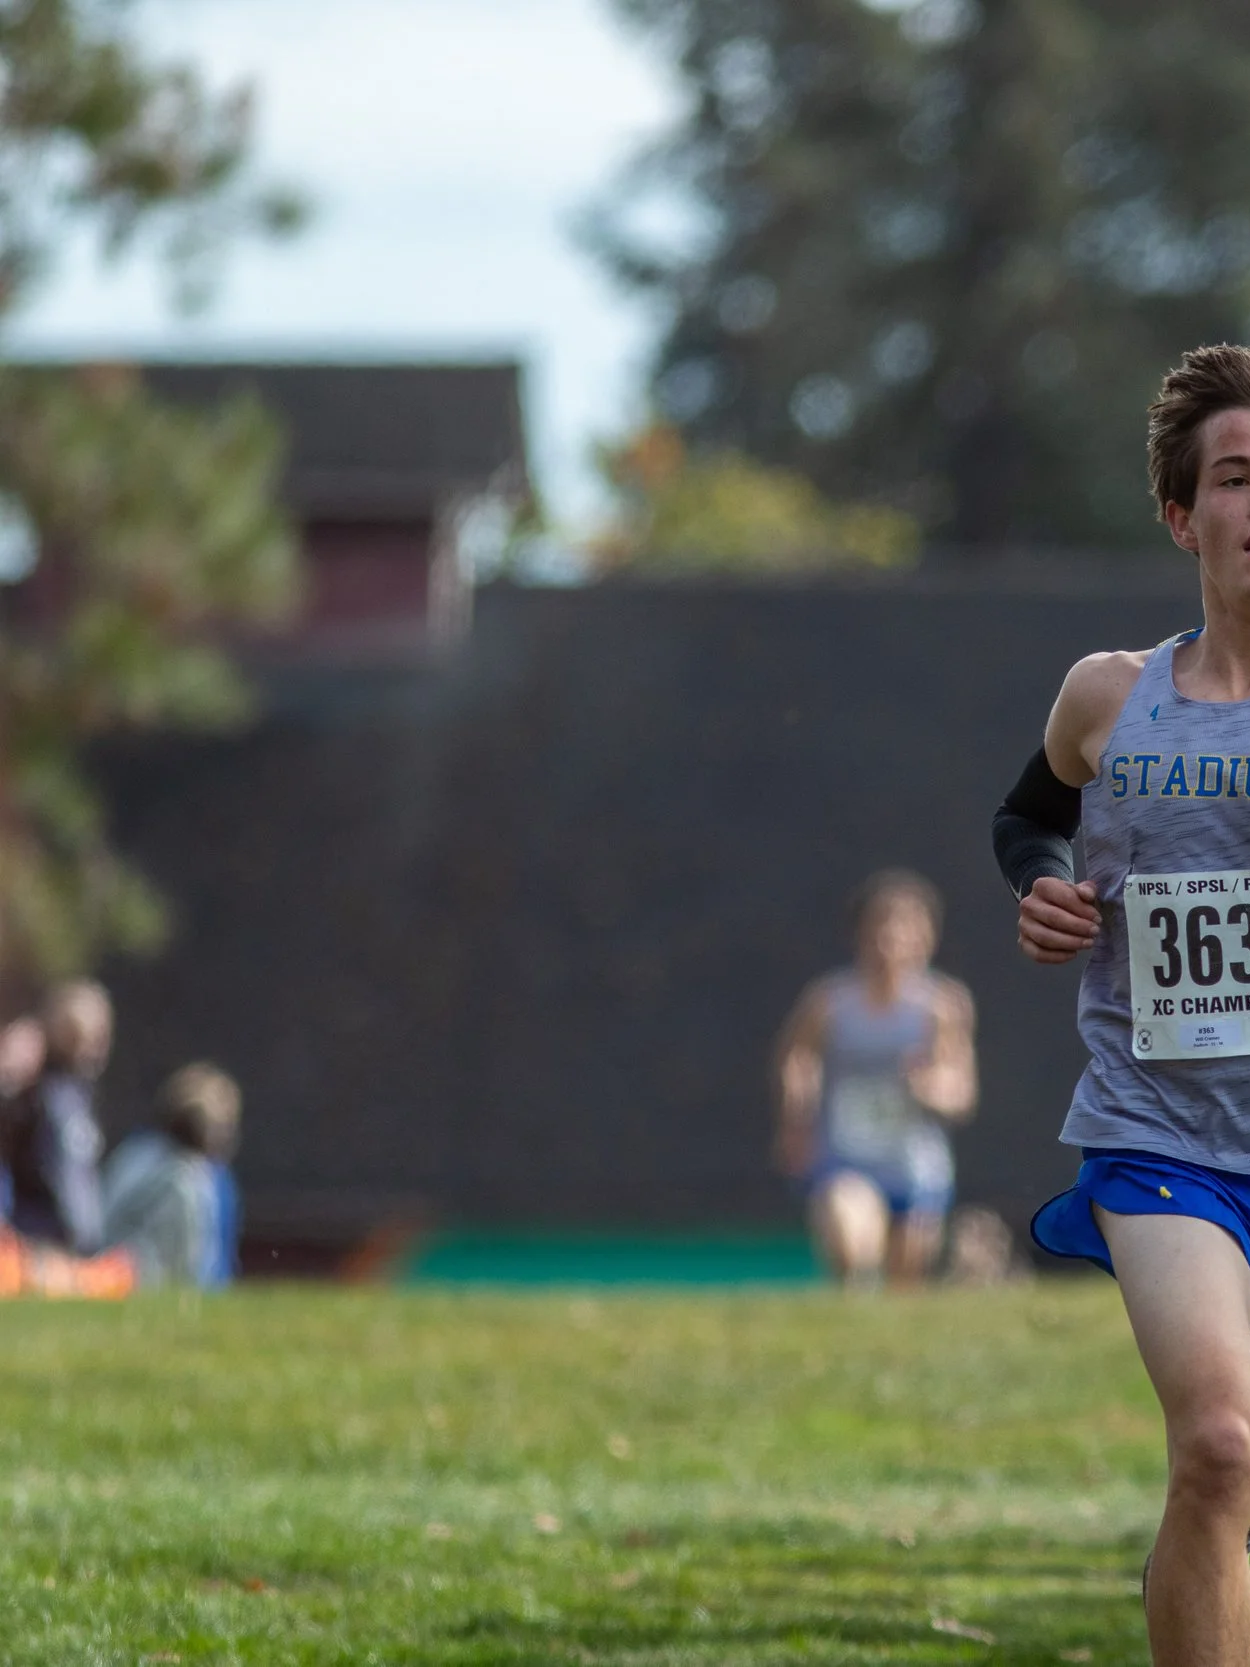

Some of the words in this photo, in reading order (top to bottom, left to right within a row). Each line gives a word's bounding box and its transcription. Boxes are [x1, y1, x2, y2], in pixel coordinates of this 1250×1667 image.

[1138, 882, 1172, 896] NPSL
[1175, 881, 1182, 896] /
[1186, 879, 1228, 894] SPSL
[1232, 878, 1239, 893] /
[1152, 998, 1175, 1016] XC
